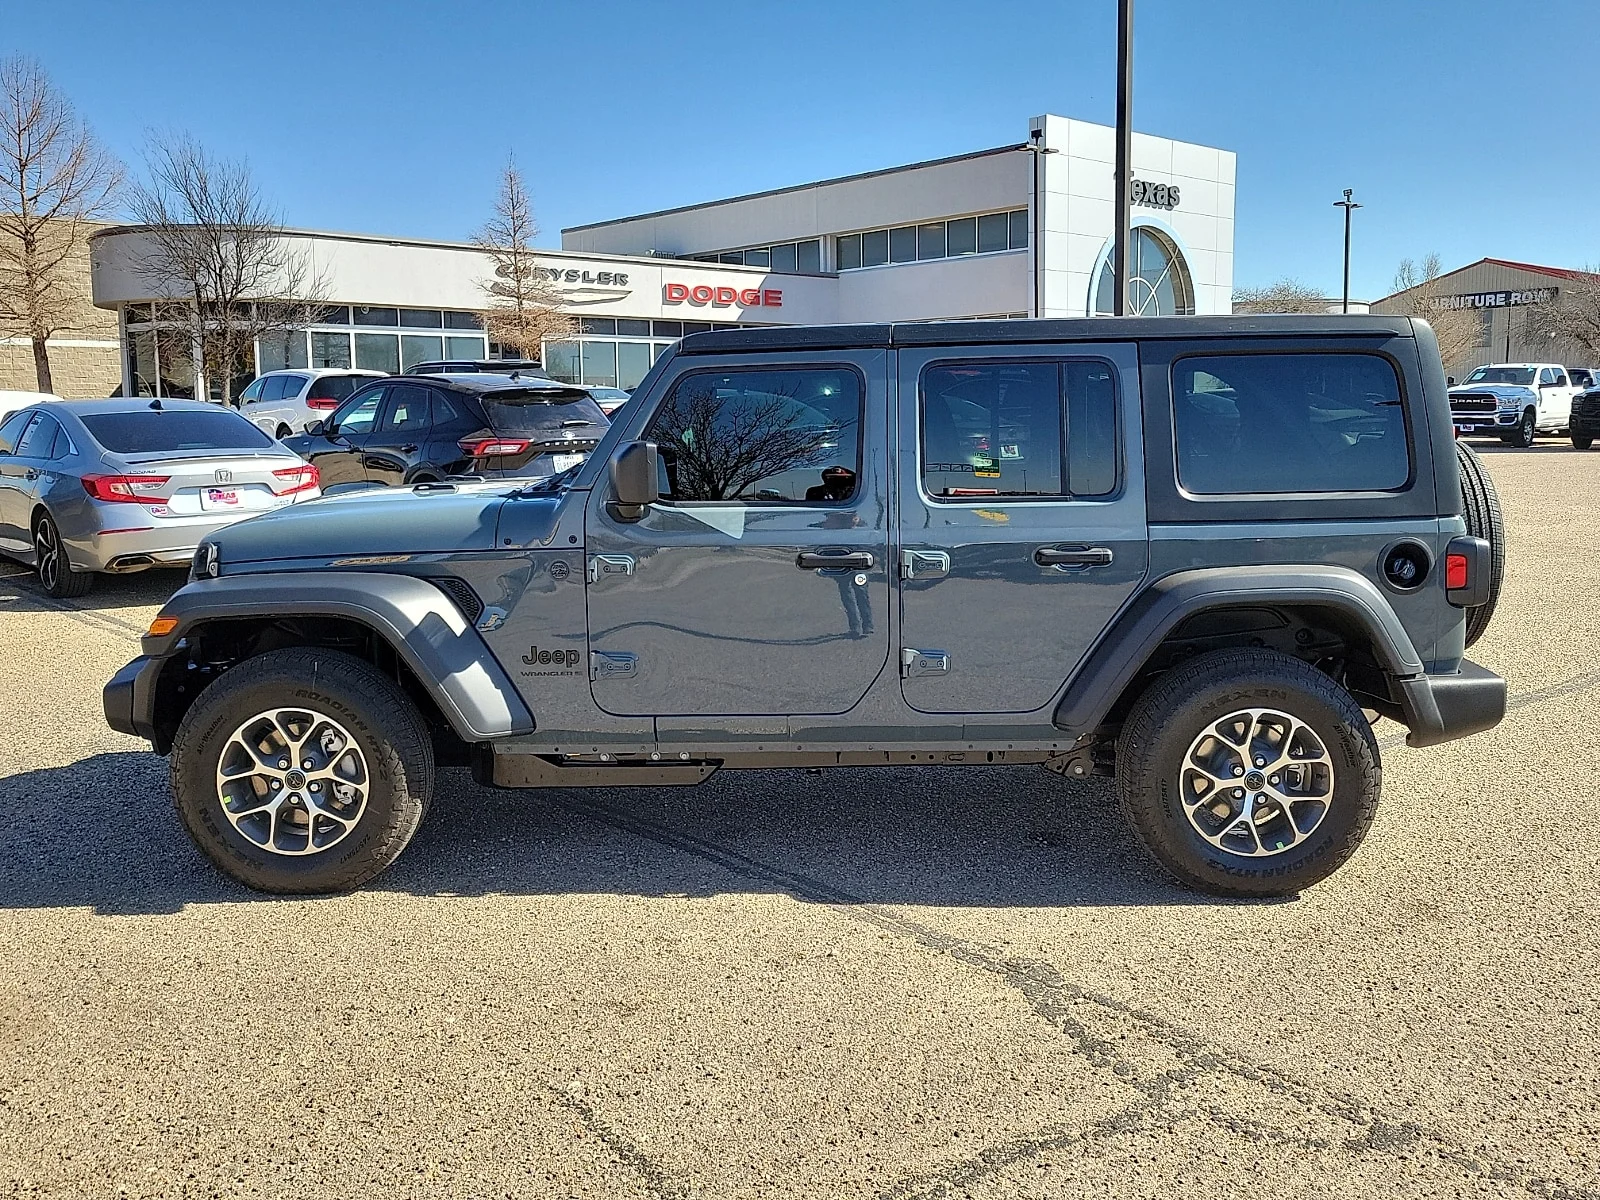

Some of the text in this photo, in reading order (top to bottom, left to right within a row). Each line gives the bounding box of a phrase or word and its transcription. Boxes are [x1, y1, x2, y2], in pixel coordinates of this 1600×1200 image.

[495, 263, 629, 286] CHRYSLER
[665, 283, 783, 307] DODGE
[521, 645, 580, 668] Jeep
[295, 689, 368, 732] ROADIAN
